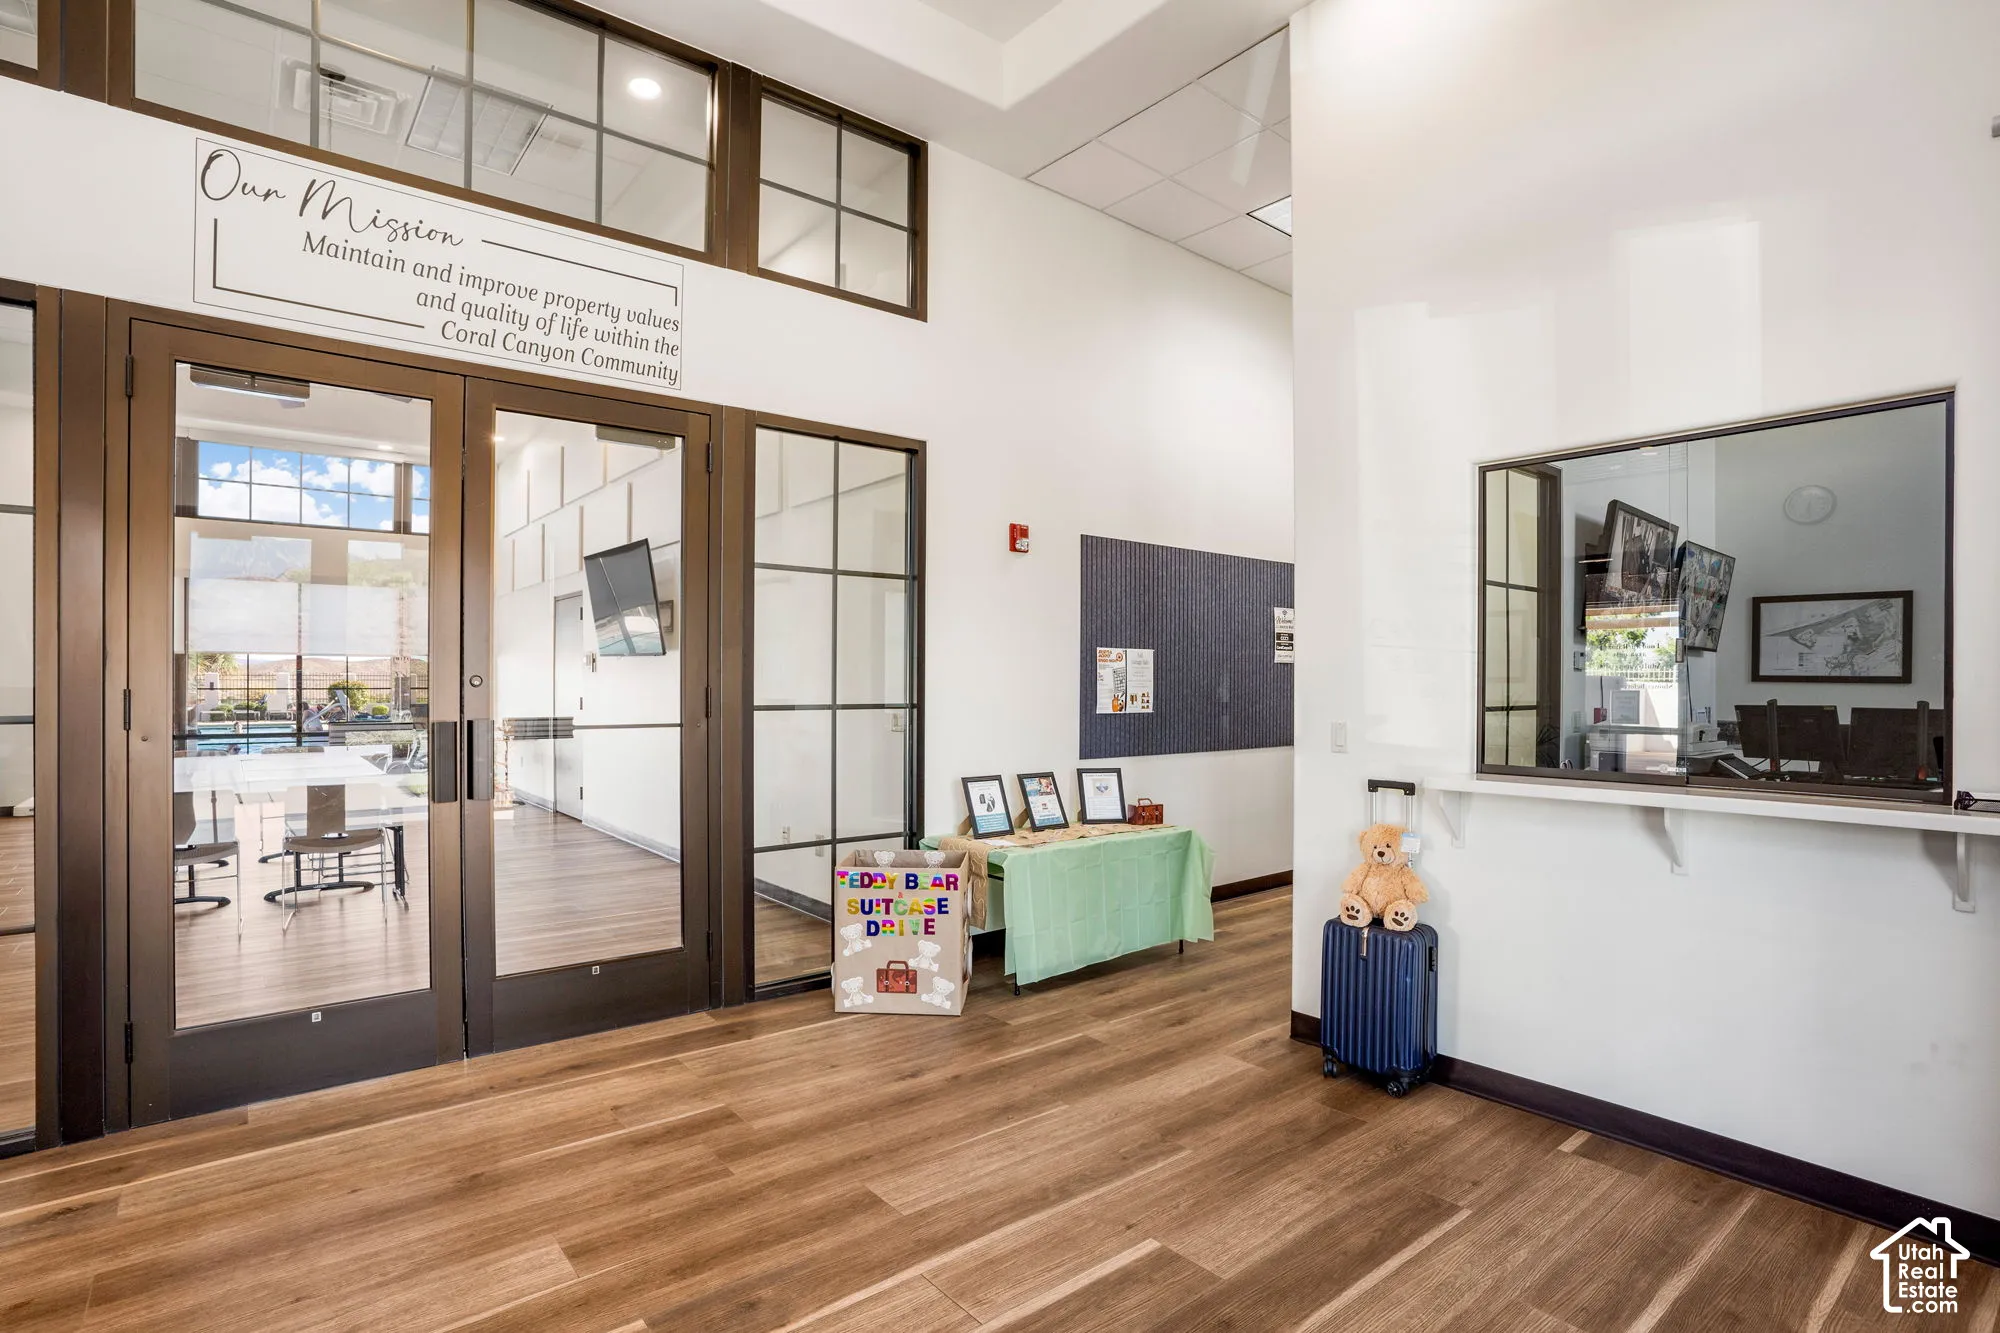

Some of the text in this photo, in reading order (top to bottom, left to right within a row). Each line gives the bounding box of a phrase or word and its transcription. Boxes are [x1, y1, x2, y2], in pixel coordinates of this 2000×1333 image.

[200, 148, 464, 247] Our Mission
[302, 231, 680, 332] Maintain and improve property values
[416, 292, 679, 357] and quality of life within the
[441, 320, 679, 386] Coral Canyon Community
[836, 870, 959, 891] TEDDY BEAR
[847, 897, 949, 916] SUITCASE
[866, 918, 936, 937] DRIVE
